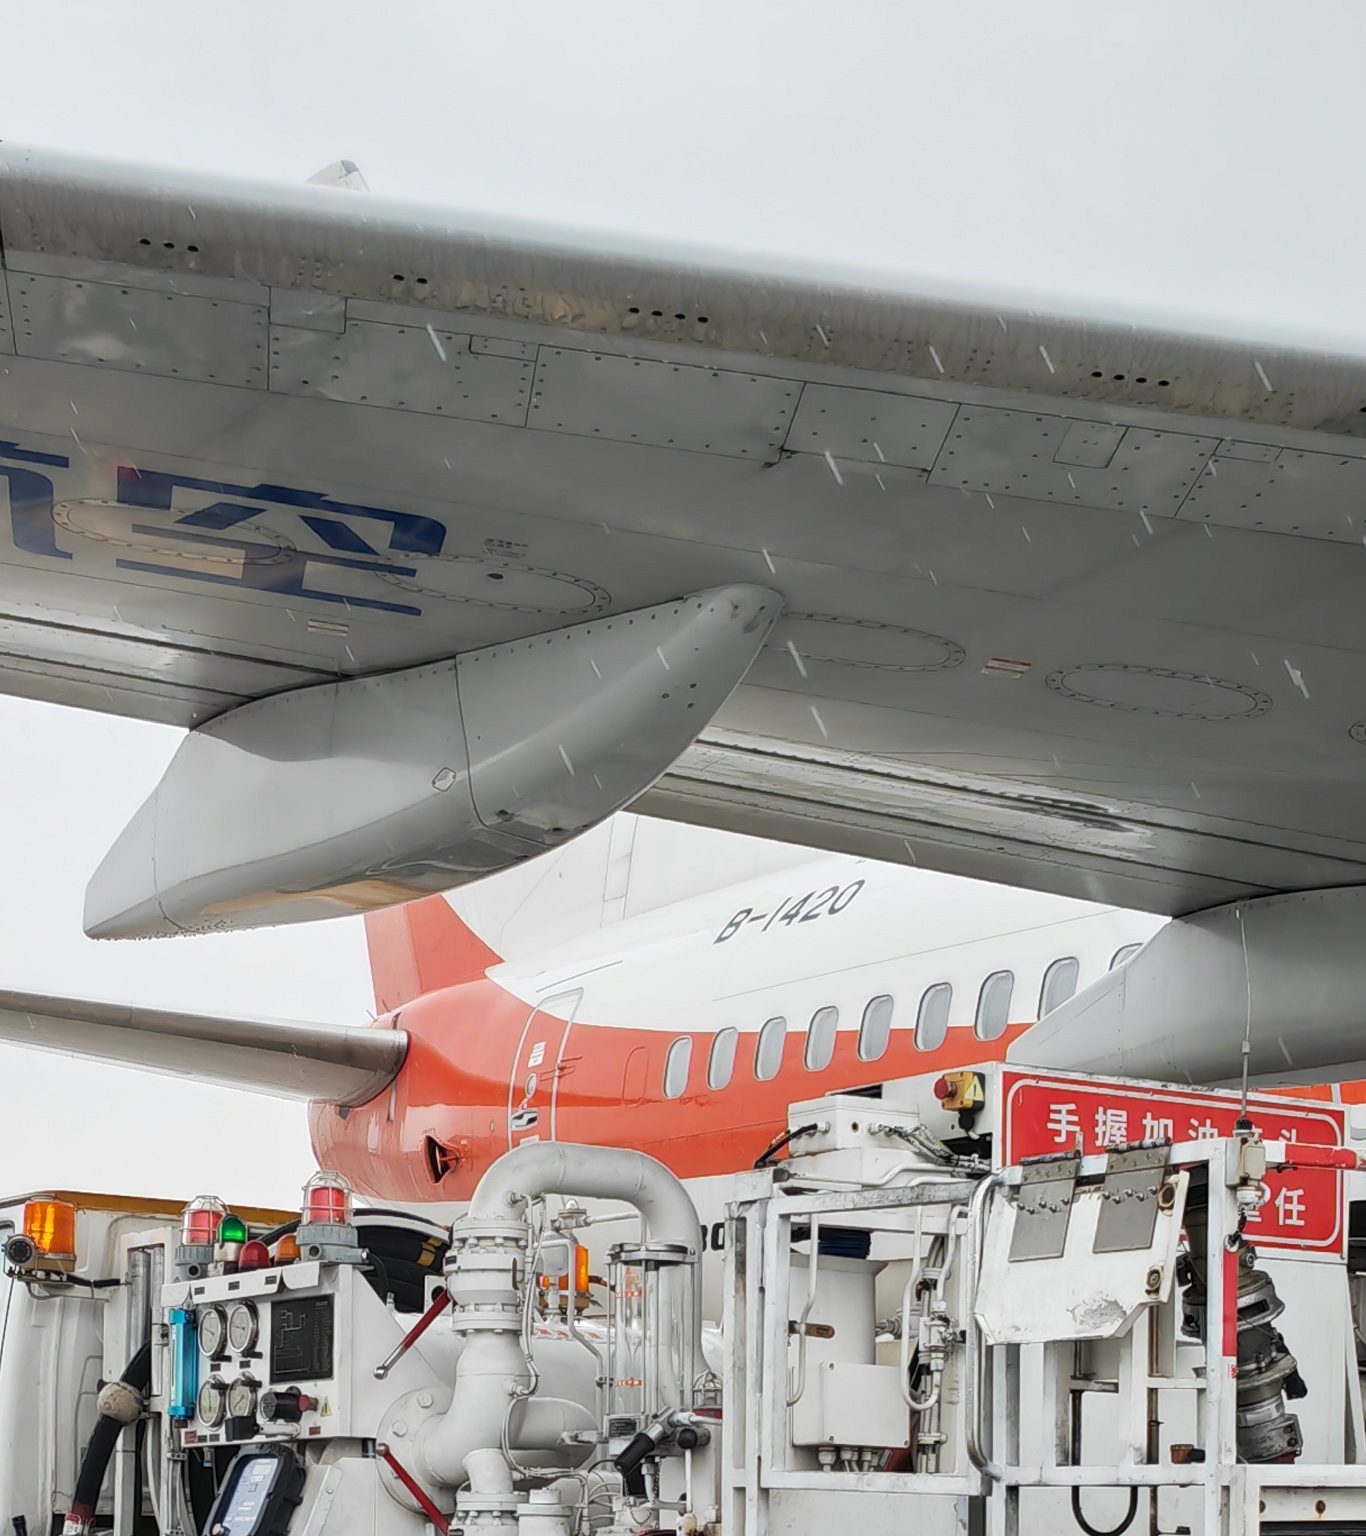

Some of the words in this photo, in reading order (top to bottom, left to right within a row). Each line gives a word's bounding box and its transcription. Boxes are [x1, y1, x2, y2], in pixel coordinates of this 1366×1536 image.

[713, 879, 866, 945] B-1420
[1046, 1103, 1299, 1147] 手握加油
